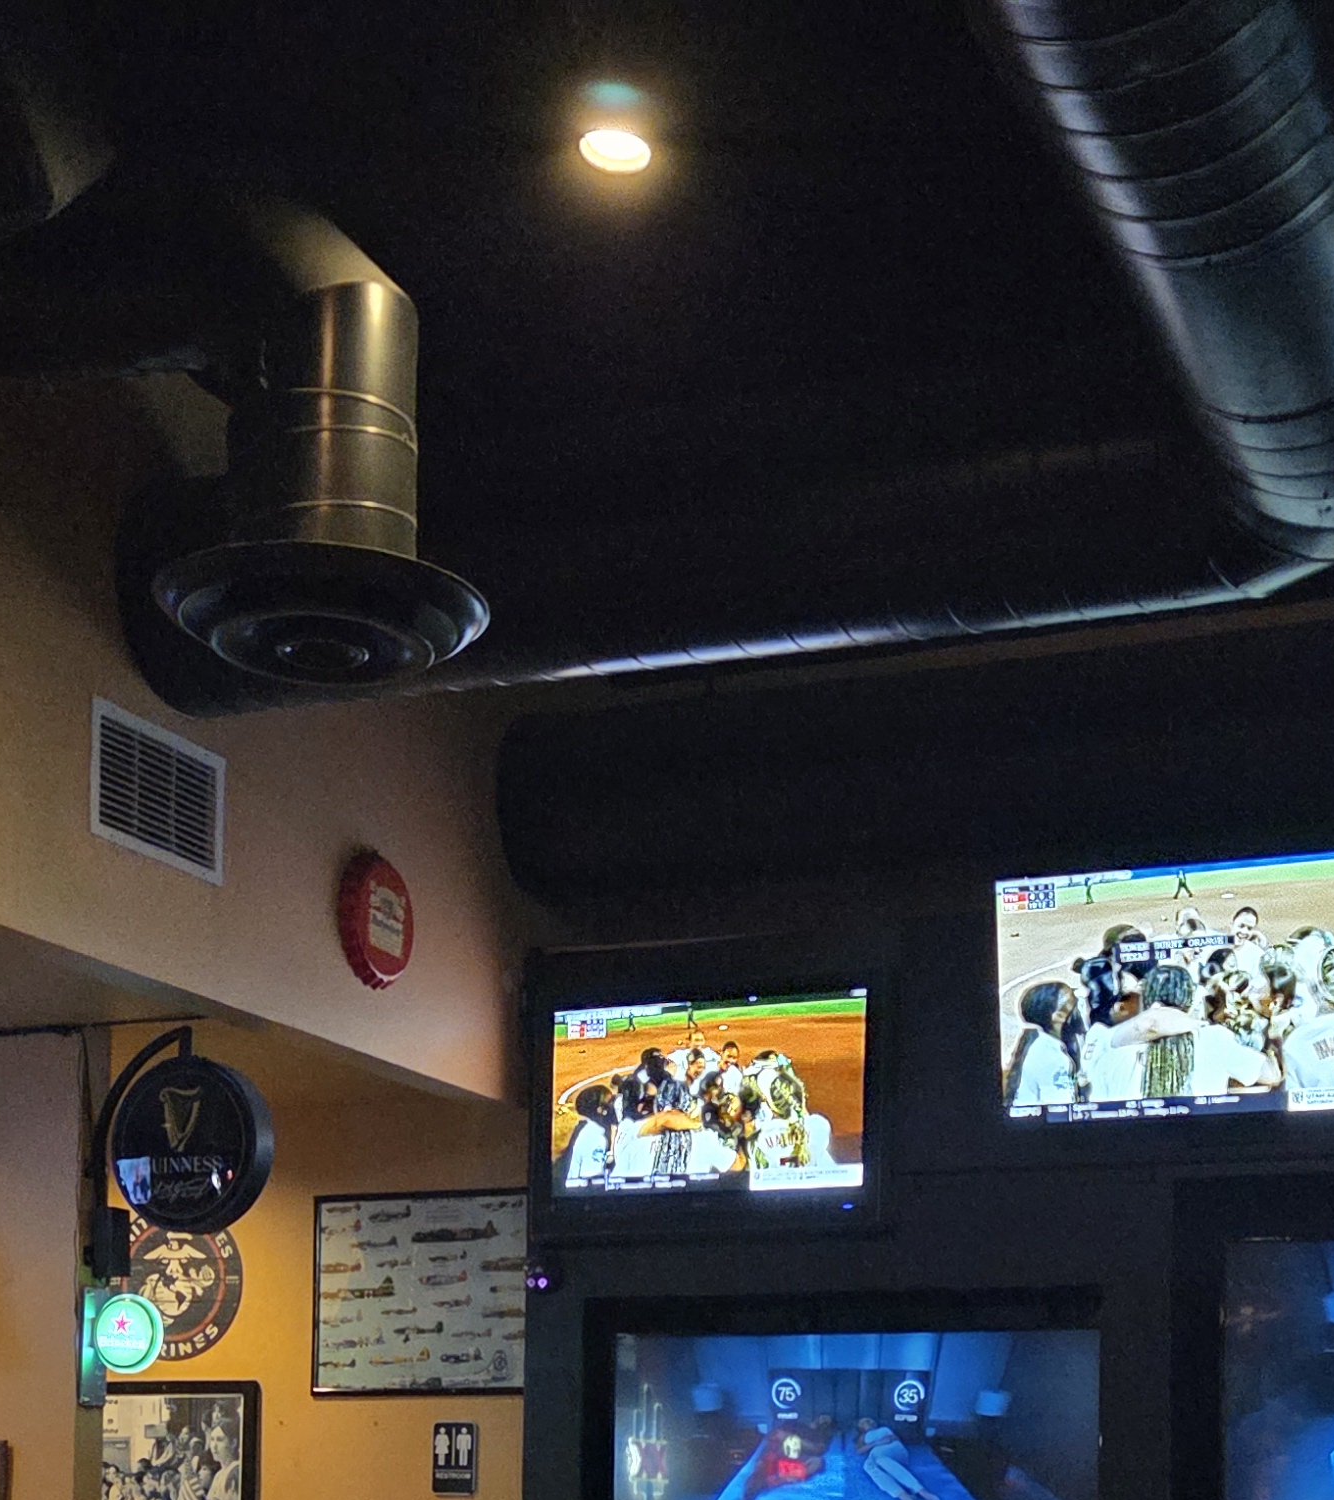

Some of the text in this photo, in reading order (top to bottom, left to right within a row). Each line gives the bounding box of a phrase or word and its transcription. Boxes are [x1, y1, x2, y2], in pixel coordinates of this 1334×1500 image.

[1187, 936, 1225, 947] ORANGE
[151, 1154, 223, 1175] UINNESS
[777, 1386, 918, 1404] 75 35
